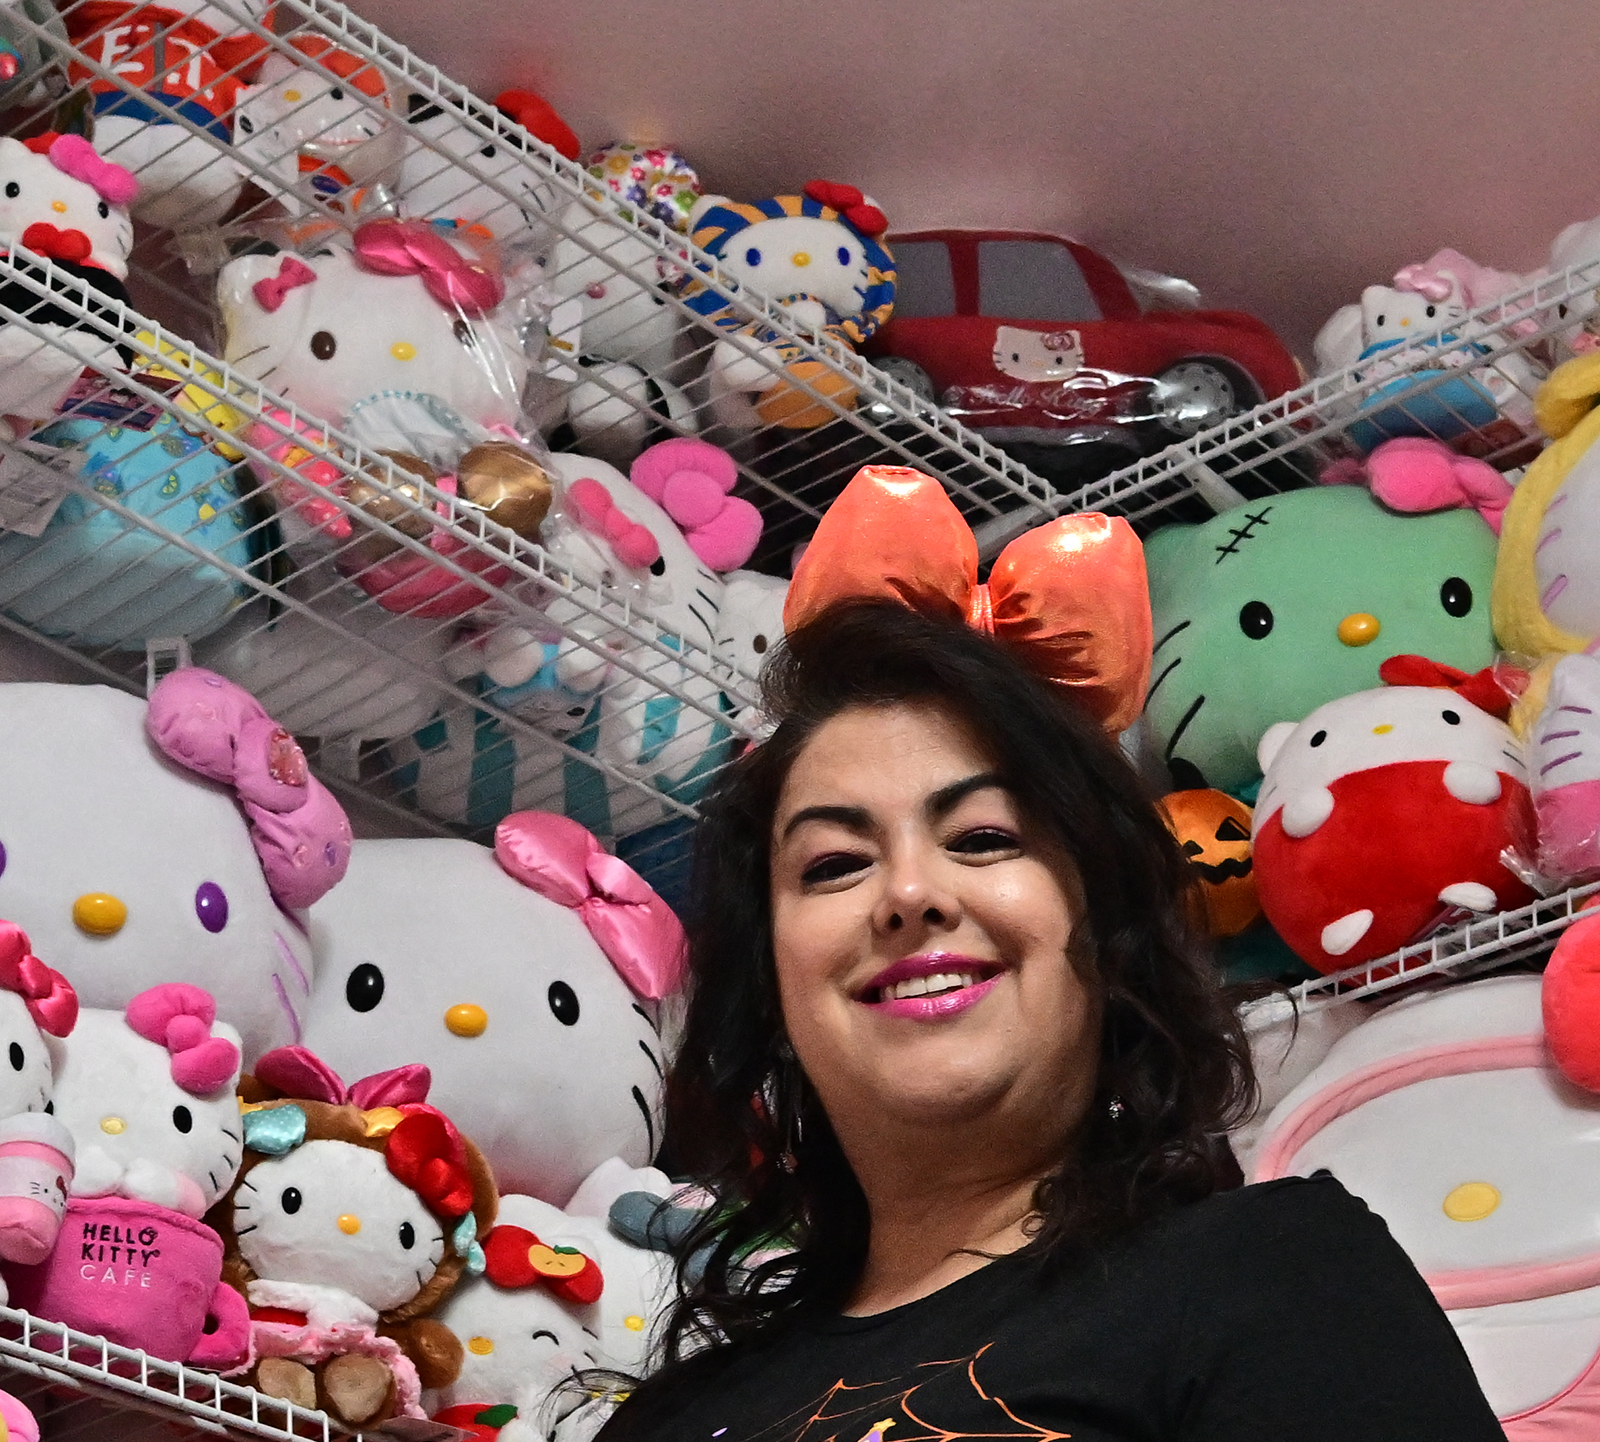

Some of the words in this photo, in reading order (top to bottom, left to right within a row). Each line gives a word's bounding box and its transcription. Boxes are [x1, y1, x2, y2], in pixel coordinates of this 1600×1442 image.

[83, 1222, 158, 1246] HELLO
[81, 1242, 161, 1268] KITTY
[80, 1264, 152, 1288] CAFE
